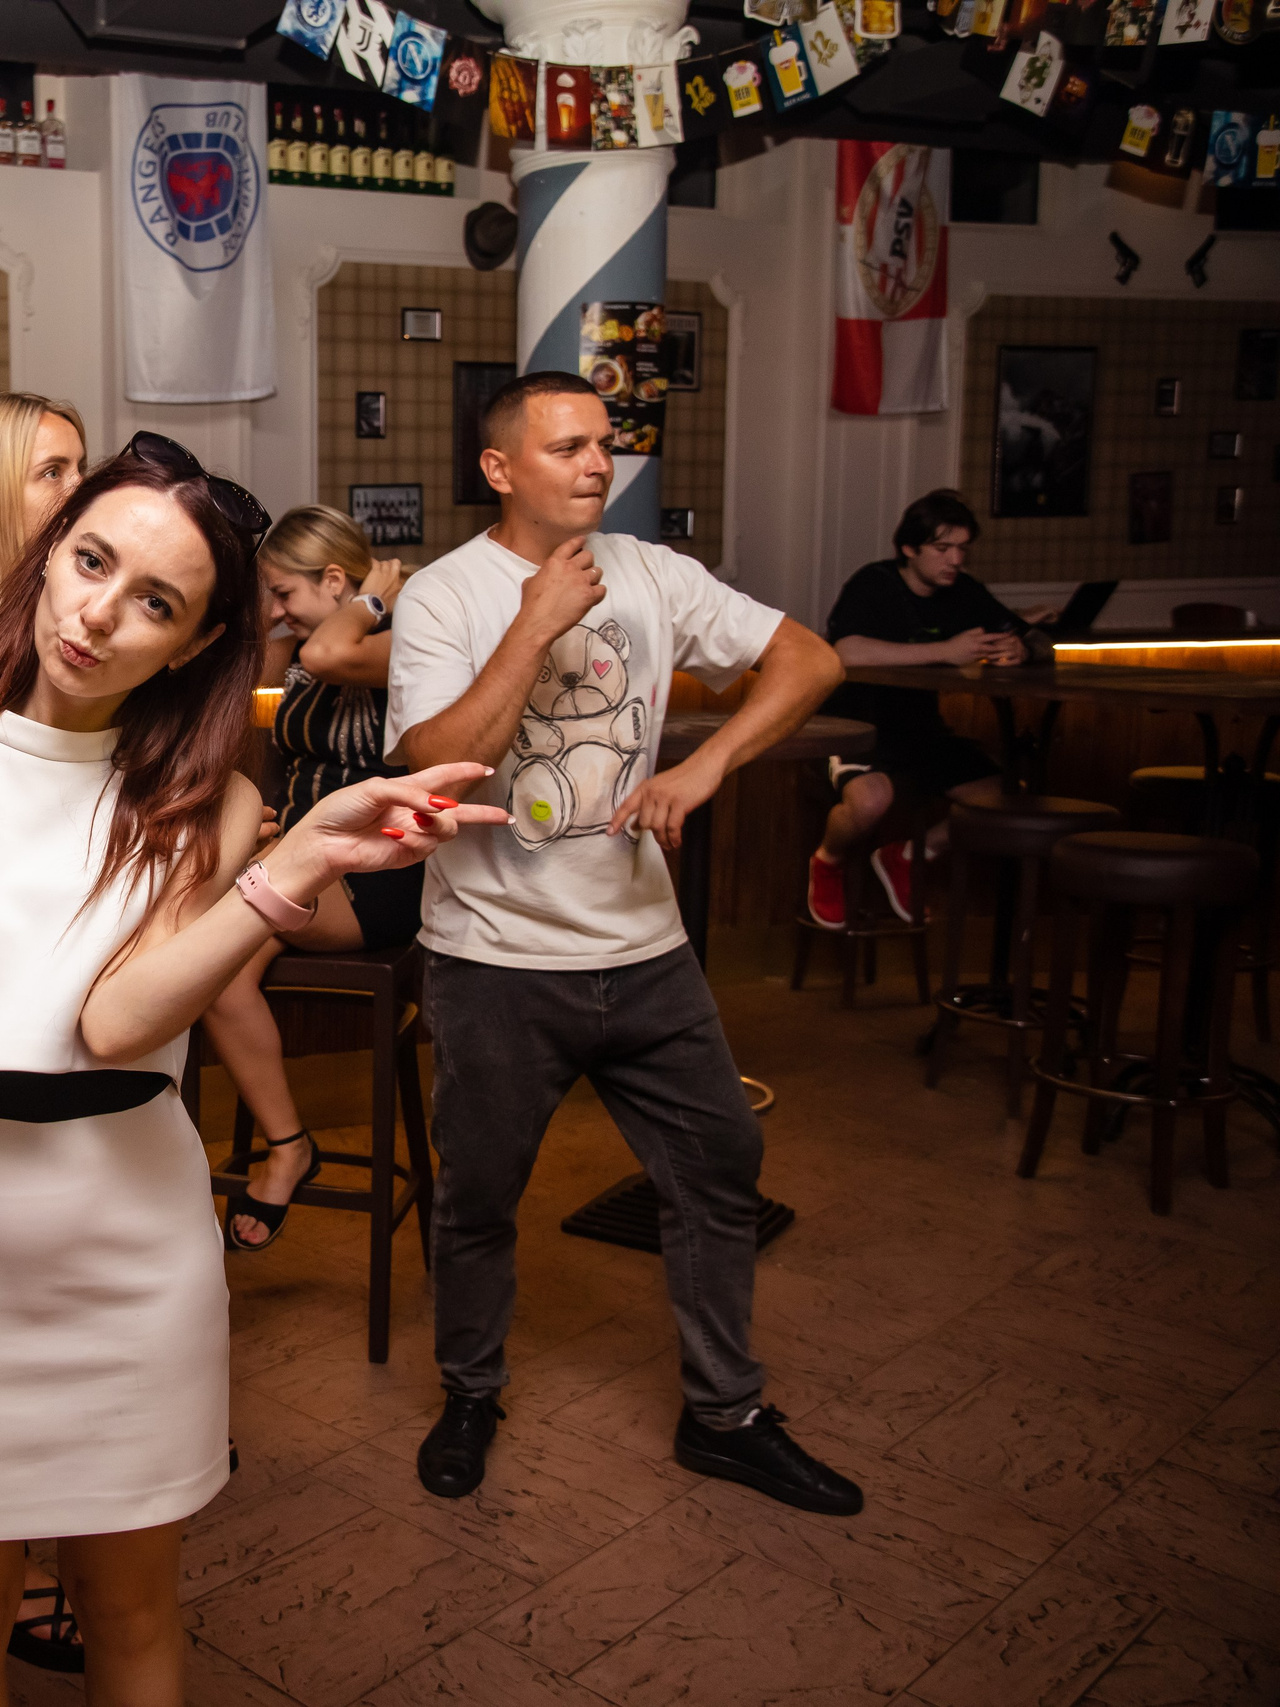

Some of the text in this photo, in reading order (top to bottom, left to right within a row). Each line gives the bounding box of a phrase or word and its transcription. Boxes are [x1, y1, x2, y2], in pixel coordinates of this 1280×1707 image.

[734, 87, 751, 101] BEER
[138, 115, 180, 247] RANGES
[888, 195, 915, 260] PSV
